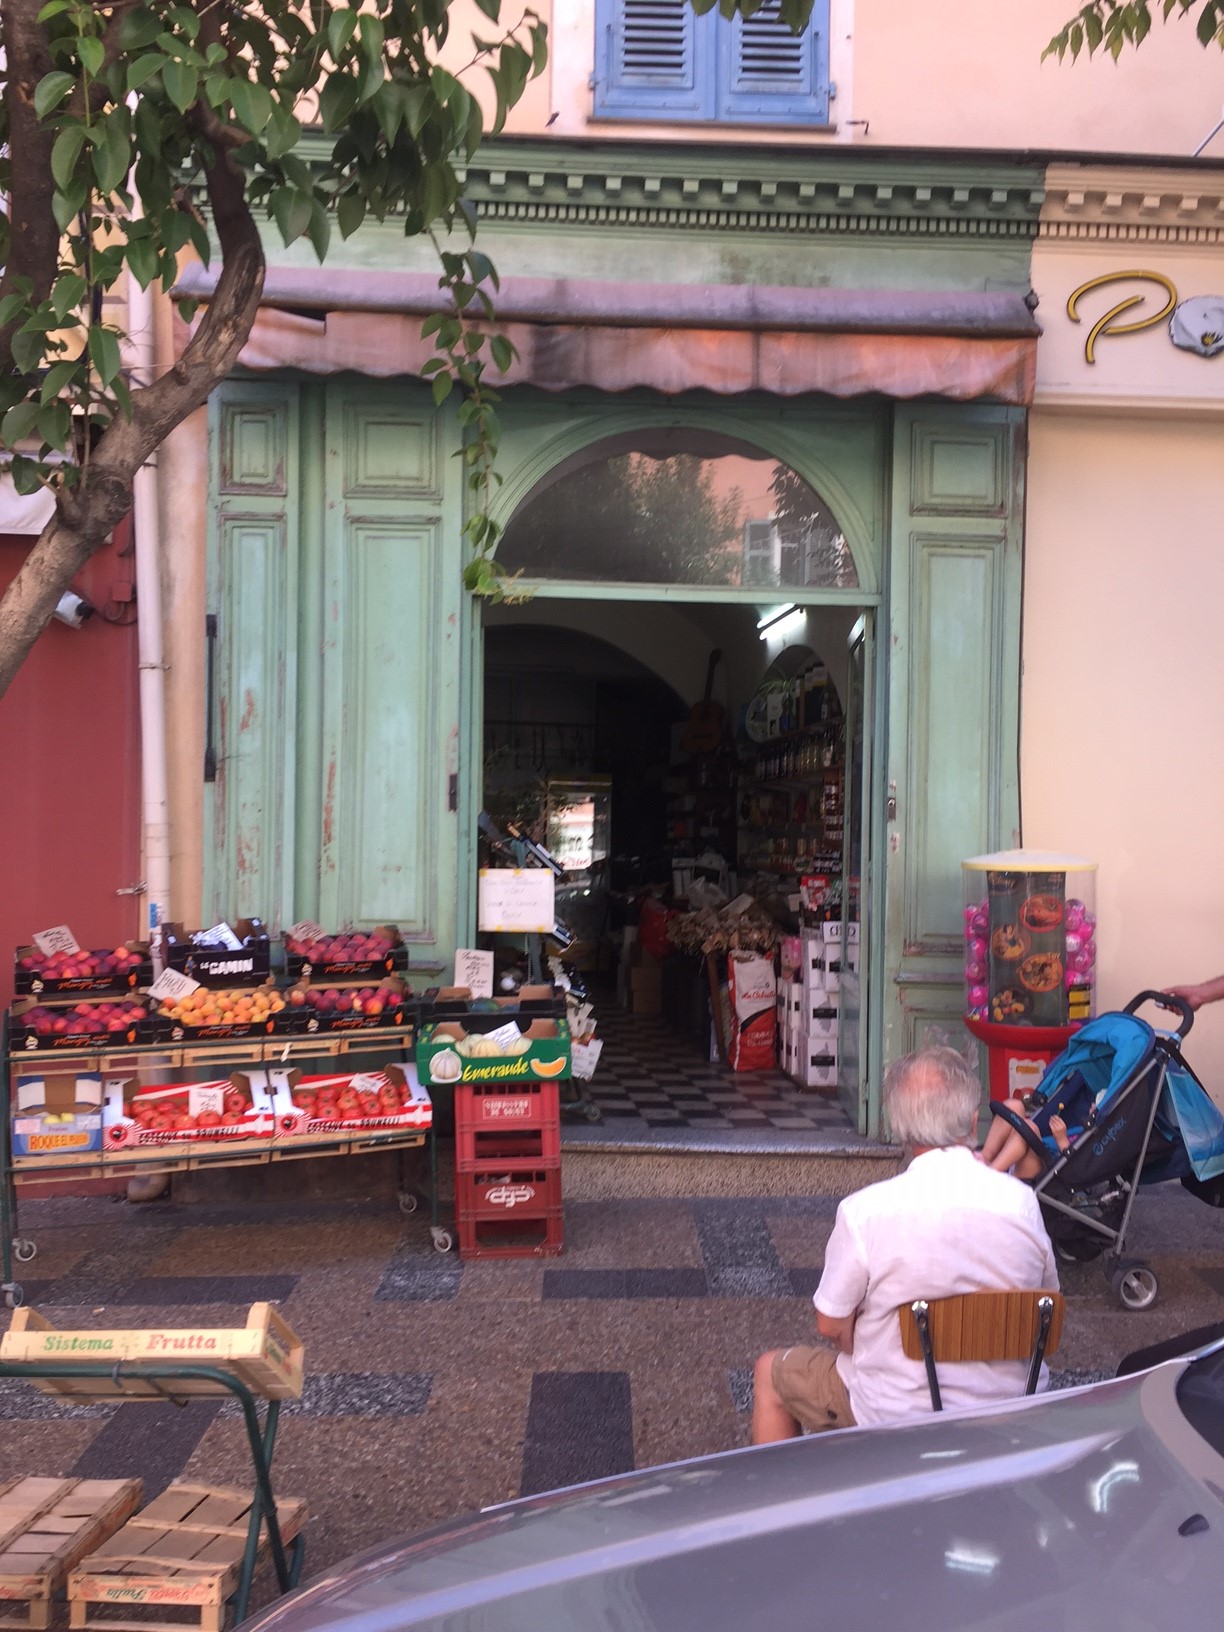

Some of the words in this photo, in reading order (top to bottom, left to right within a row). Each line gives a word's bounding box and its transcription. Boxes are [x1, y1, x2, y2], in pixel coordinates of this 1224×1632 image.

[1066, 269, 1178, 365] P
[209, 957, 254, 975] GAMIN
[462, 1057, 530, 1082] Emeraude
[43, 1334, 114, 1351] Sistema
[146, 1333, 217, 1351] Frutta
